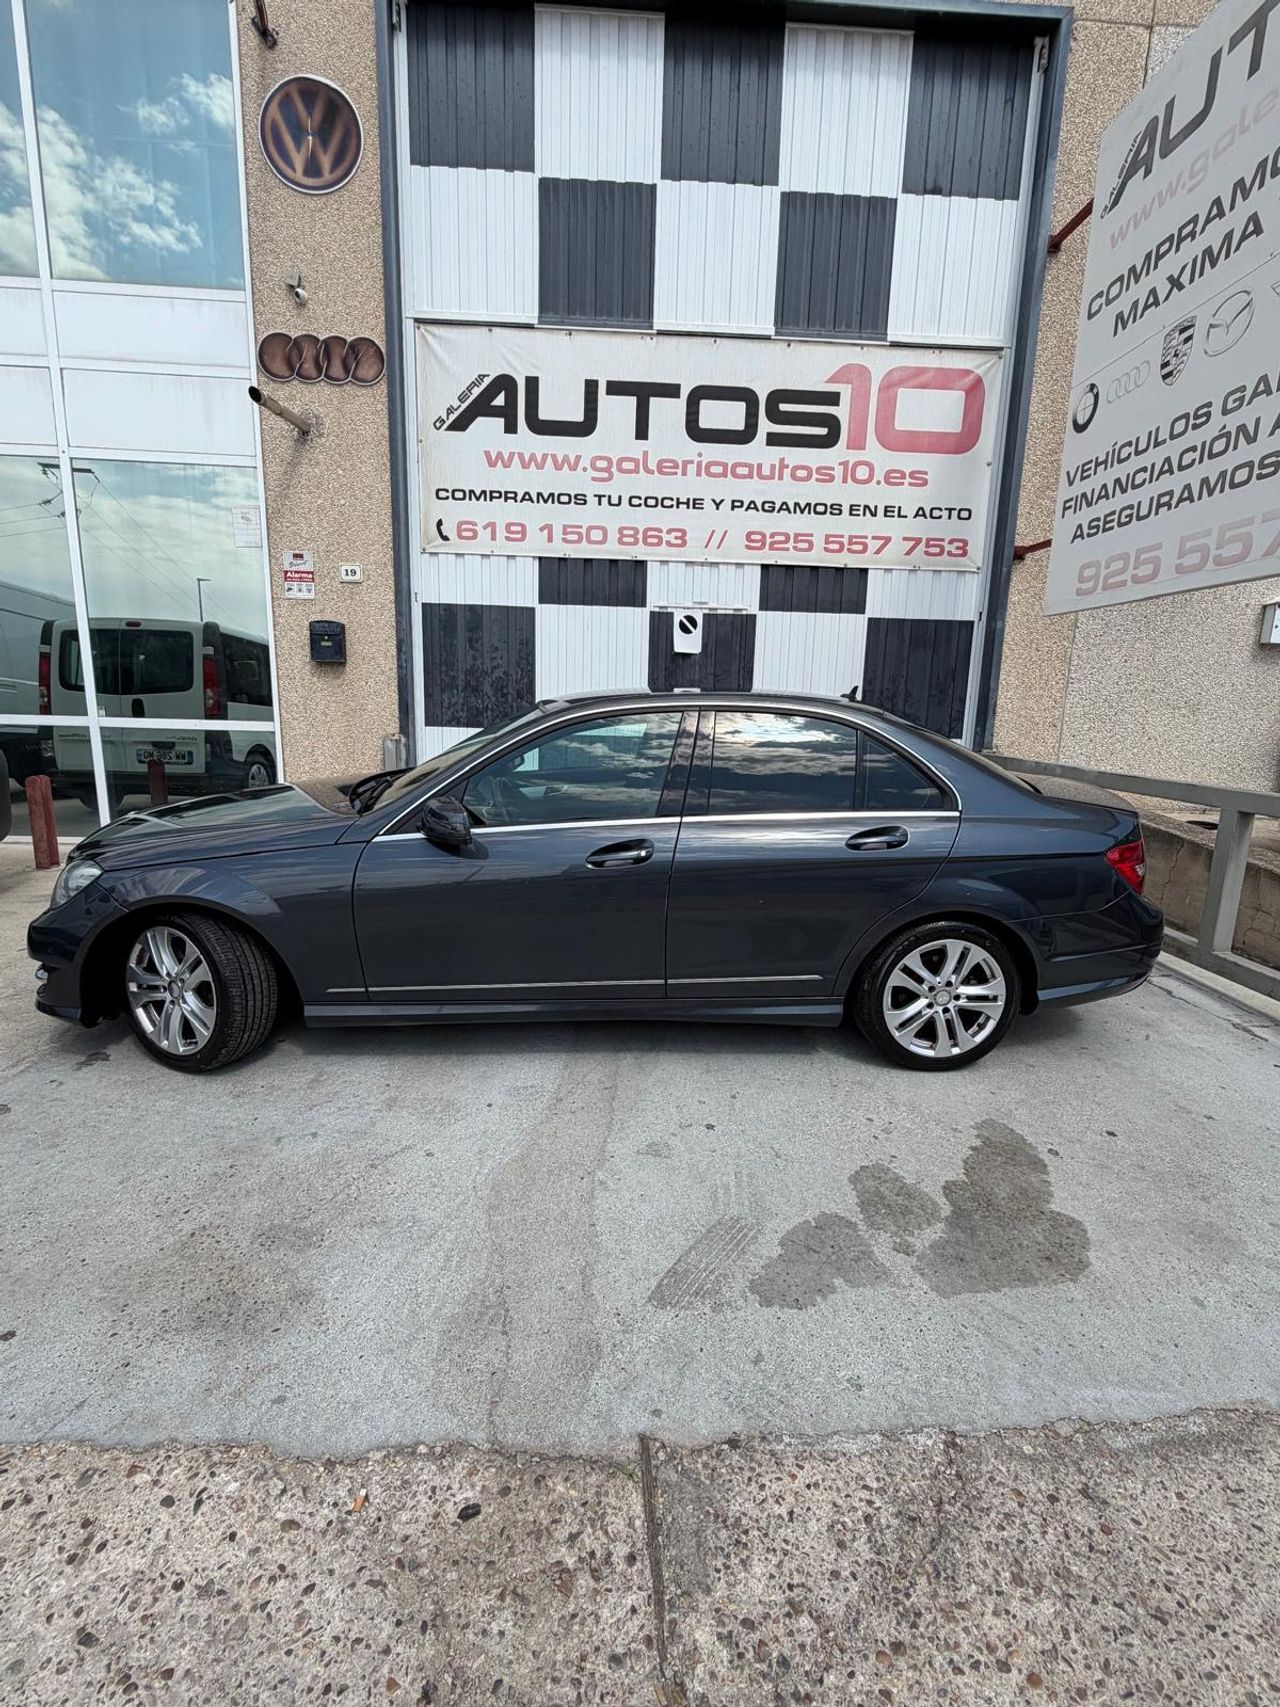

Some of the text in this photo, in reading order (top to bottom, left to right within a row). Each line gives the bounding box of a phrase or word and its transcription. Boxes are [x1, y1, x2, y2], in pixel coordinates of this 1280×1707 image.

[1113, 211, 1264, 338] MAXIMA
[432, 373, 491, 431] GALERIA
[444, 362, 985, 455] AUTOS10
[1066, 401, 1213, 487] VEHÍCULOS
[1221, 369, 1280, 416] GA
[484, 449, 929, 488] www.galeriaautos10.es
[1061, 416, 1261, 519] FINANCIACIÓN
[1070, 449, 1280, 544] ASEGURAMOS
[435, 487, 972, 521] COMPRAMOS TU COCHE Y PAGAMOS EN EL ACTO
[456, 519, 527, 543] 619
[538, 522, 608, 545] 150
[617, 525, 688, 548] 863
[744, 530, 814, 554] 925
[823, 533, 892, 556] 557
[902, 536, 969, 558] 753
[344, 568, 357, 577] 19
[1075, 541, 1163, 597] 925
